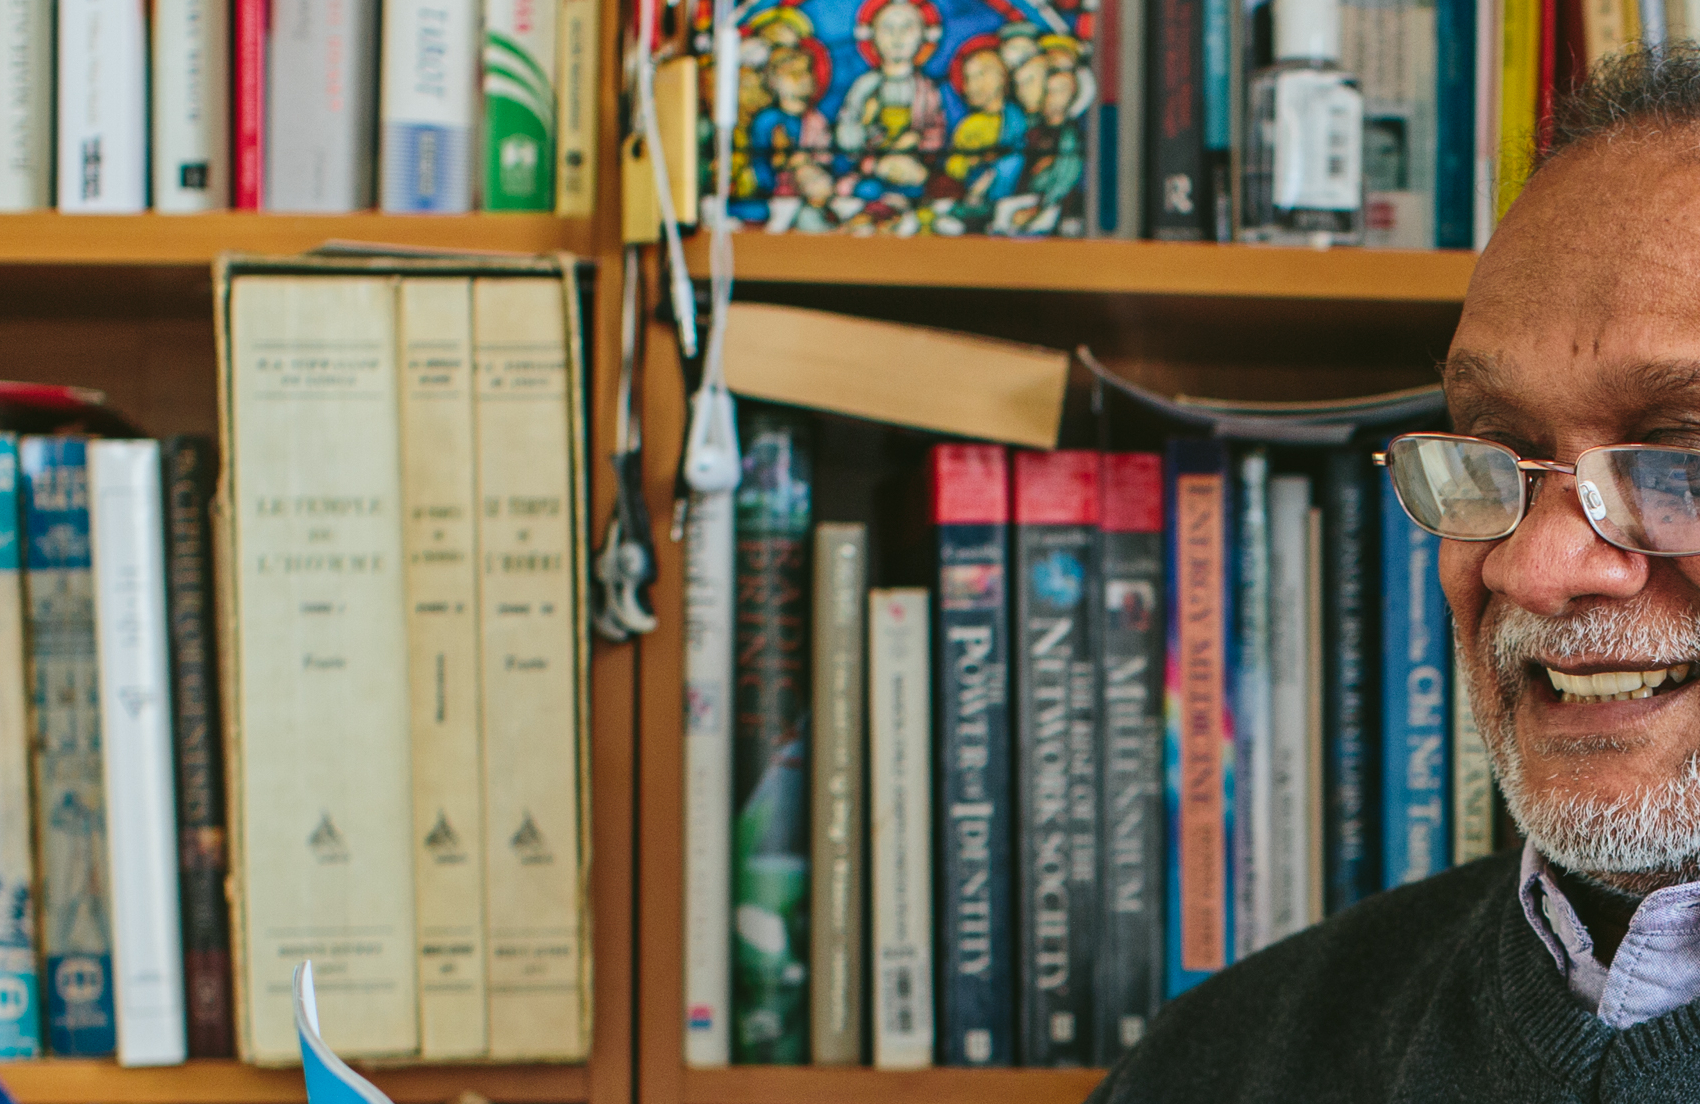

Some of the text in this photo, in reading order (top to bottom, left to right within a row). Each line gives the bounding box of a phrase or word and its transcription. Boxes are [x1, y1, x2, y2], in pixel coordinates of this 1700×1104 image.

[948, 625, 995, 772] POWER
[1029, 618, 1074, 991] NETWORK SOCIETY
[1103, 656, 1148, 915] MILLENNIUM
[946, 802, 996, 979] IDENTITY
